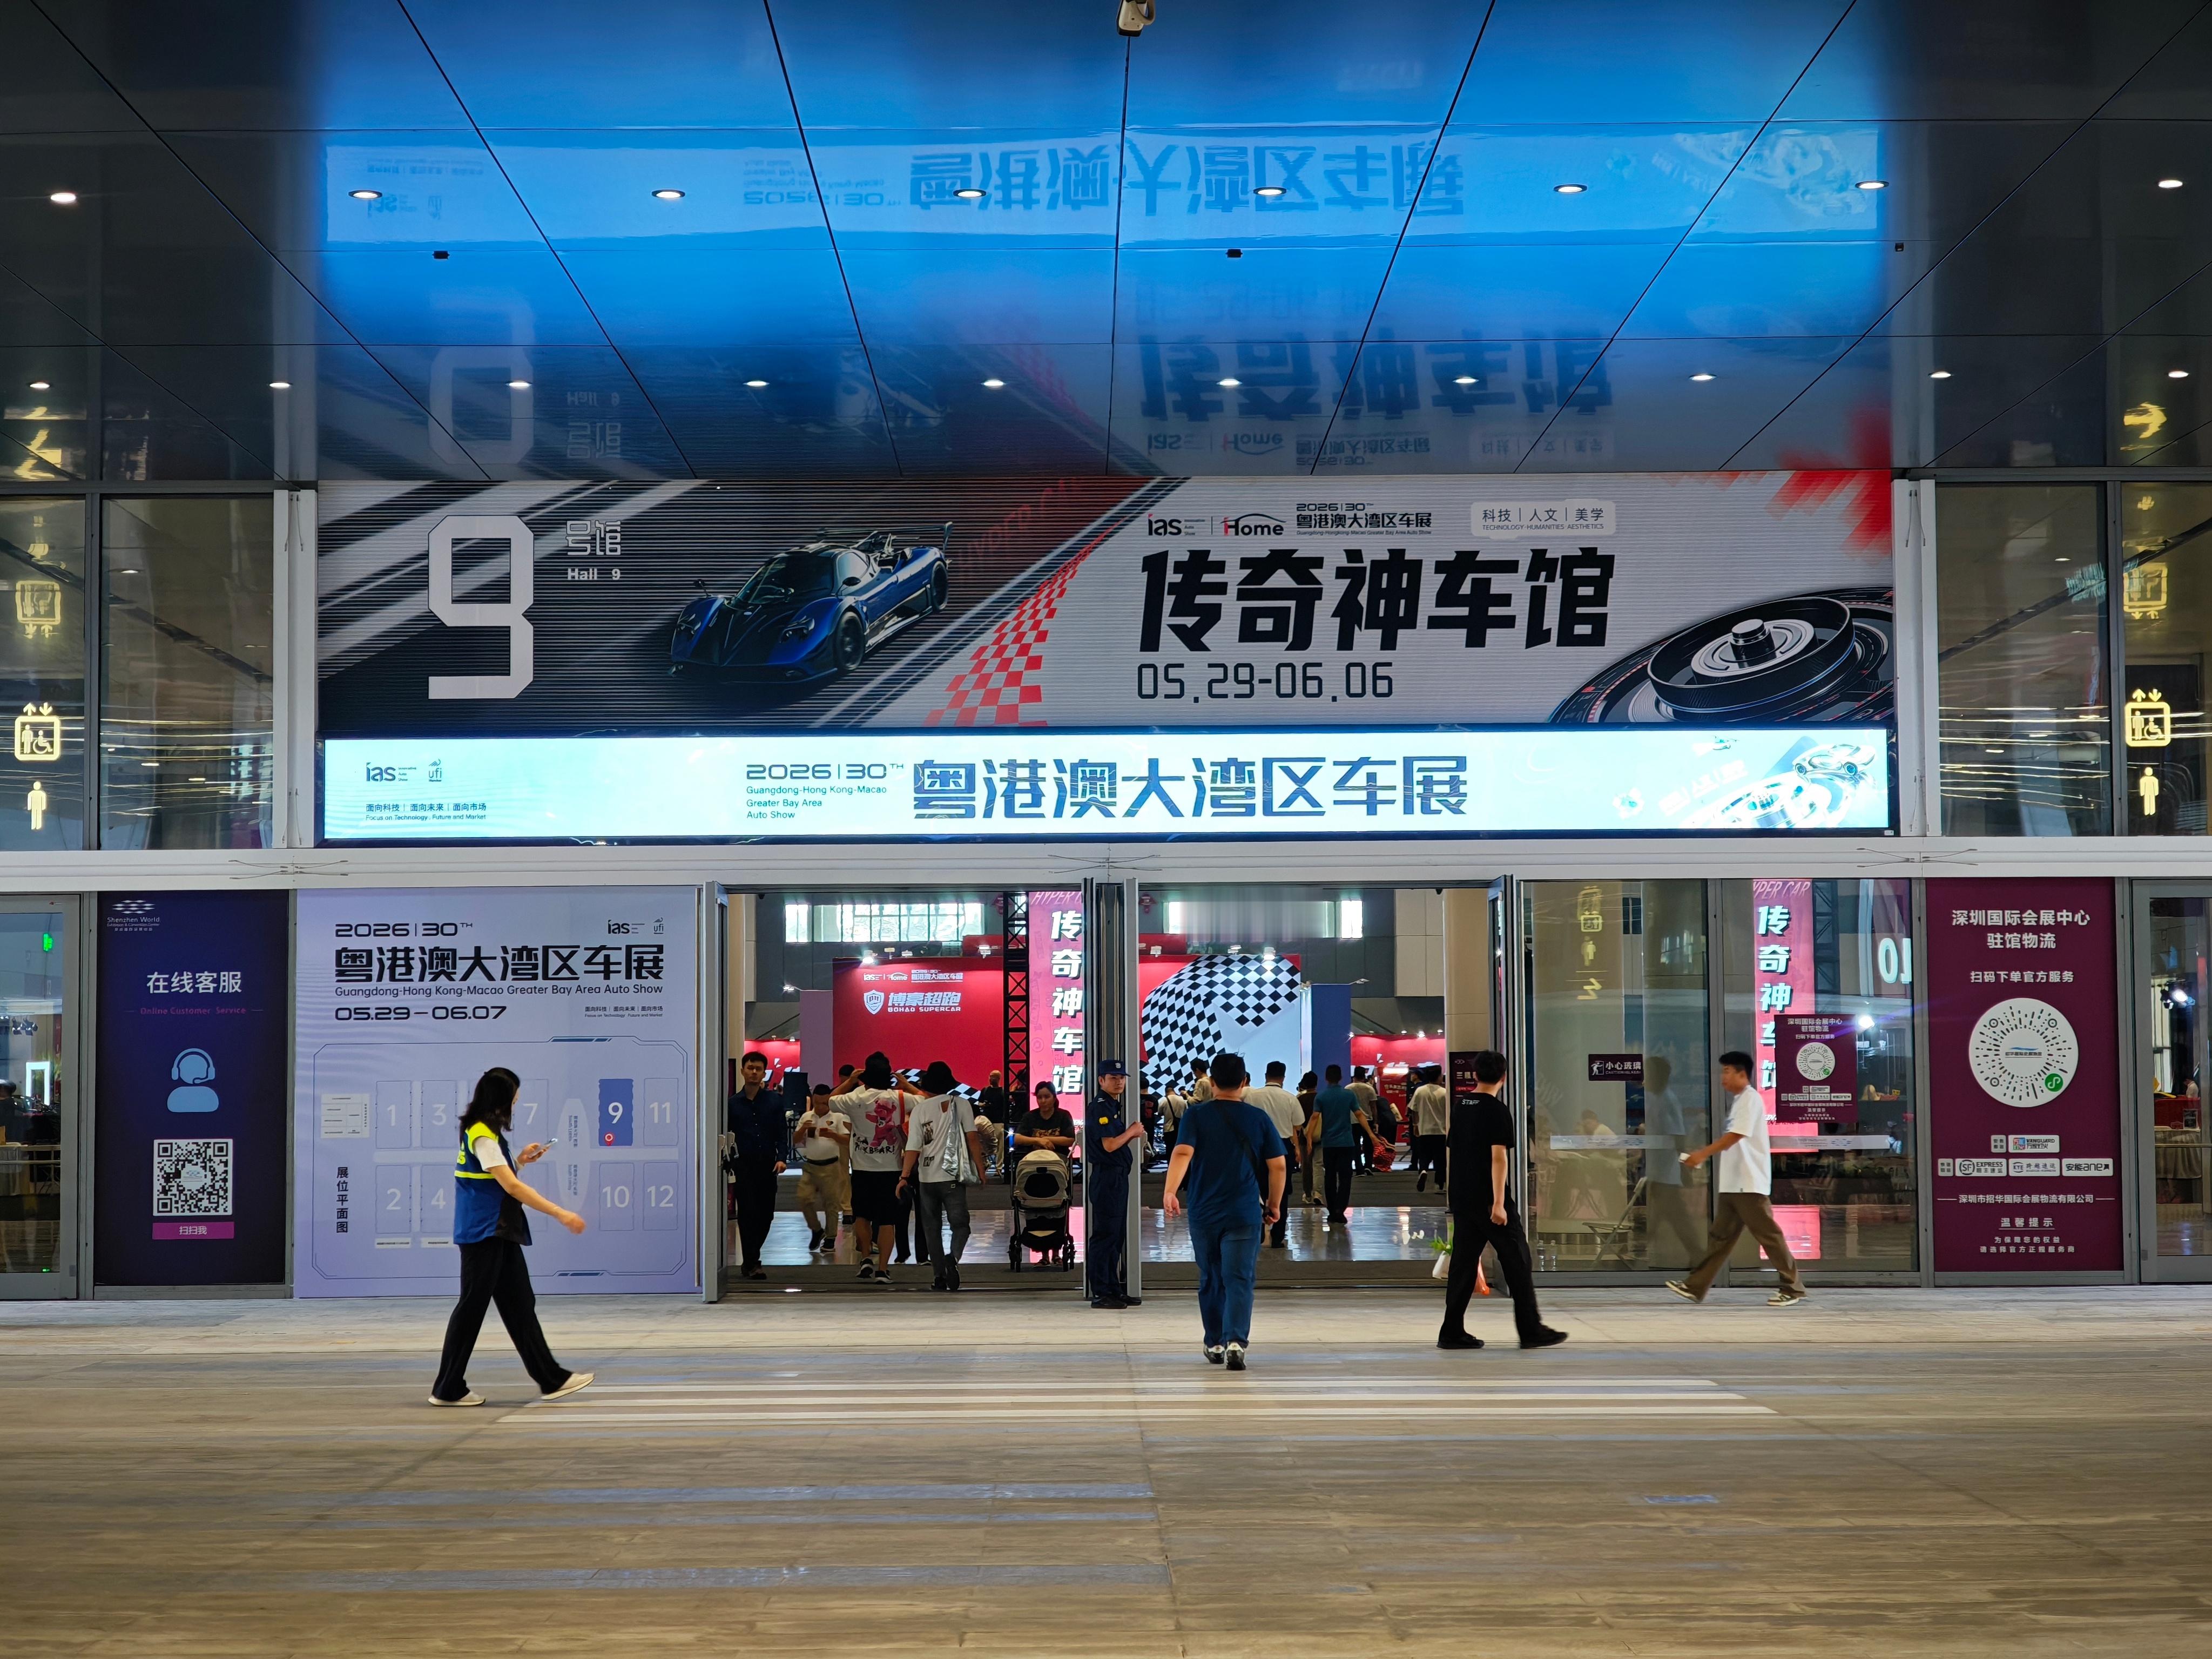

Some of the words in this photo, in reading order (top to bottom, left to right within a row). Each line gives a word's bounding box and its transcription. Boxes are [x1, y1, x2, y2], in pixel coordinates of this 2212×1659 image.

[1297, 512, 1432, 529] 粤港澳大湾区车展
[1482, 508, 1512, 522] 科技
[1529, 508, 1557, 522] 人文
[1575, 507, 1604, 522] 美学
[1148, 514, 1182, 537] ias
[566, 520, 622, 556] 号馆
[567, 568, 598, 581] Hall
[611, 568, 621, 581] 9
[428, 515, 534, 699] 9
[1139, 547, 1616, 652] 传奇神车馆
[1137, 662, 1394, 704] 05.29-06.06
[366, 762, 396, 783] ias
[428, 768, 442, 779] ufi
[746, 764, 832, 780] 2026
[746, 785, 827, 796] Guangdong-Hong
[830, 785, 887, 795] Kong-Macao
[913, 756, 1467, 819] 粤港澳大湾区车展
[366, 803, 400, 812] 面向科技
[410, 803, 444, 812] 面向未来
[453, 802, 487, 812] 面向市场
[746, 799, 780, 807] Greater
[783, 799, 800, 809] Bay
[801, 799, 822, 807] Area
[746, 811, 768, 819] Auto
[770, 811, 795, 819] Show
[1782, 881, 1811, 899] CAR
[608, 920, 630, 934] ias
[1952, 909, 2090, 927] 深圳国际会展中心
[335, 922, 409, 938] 2026
[653, 924, 664, 932] ufi
[1987, 933, 2056, 949] 驻馆物流
[335, 944, 664, 982] 粤港澳大湾区车展
[146, 972, 242, 994] 在线客服
[1970, 971, 2074, 983] 扫码下单官方服务
[335, 985, 432, 998] Guangdong-Hong
[434, 985, 504, 996] Kong-Macao
[507, 984, 548, 995] Greater
[551, 984, 572, 997] Bay
[575, 984, 601, 994] Area
[604, 984, 630, 994] Auto
[632, 983, 663, 994] Show
[888, 992, 961, 1007] 博豪超跑
[140, 1007, 168, 1015] Online
[170, 1007, 211, 1015] Customer
[216, 1007, 247, 1015] Service
[1051, 911, 1083, 1094] 传奇神车馆
[1605, 1061, 1642, 1070] 小心玻璃
[388, 1105, 396, 1127] 1
[433, 1104, 447, 1127] 3
[523, 1103, 538, 1125] 7
[608, 1102, 623, 1124] 9
[649, 1102, 672, 1124] 11
[336, 1166, 349, 1234] 展位平面图
[386, 1188, 402, 1210] 2
[430, 1188, 446, 1210] 4
[602, 1185, 630, 1209] 10
[647, 1185, 675, 1208] 12
[1959, 1194, 2094, 1204] 深圳市招华国际会展物流有限公司
[179, 1225, 207, 1236] 扫扫我
[2000, 1217, 2054, 1228] 温馨提示
